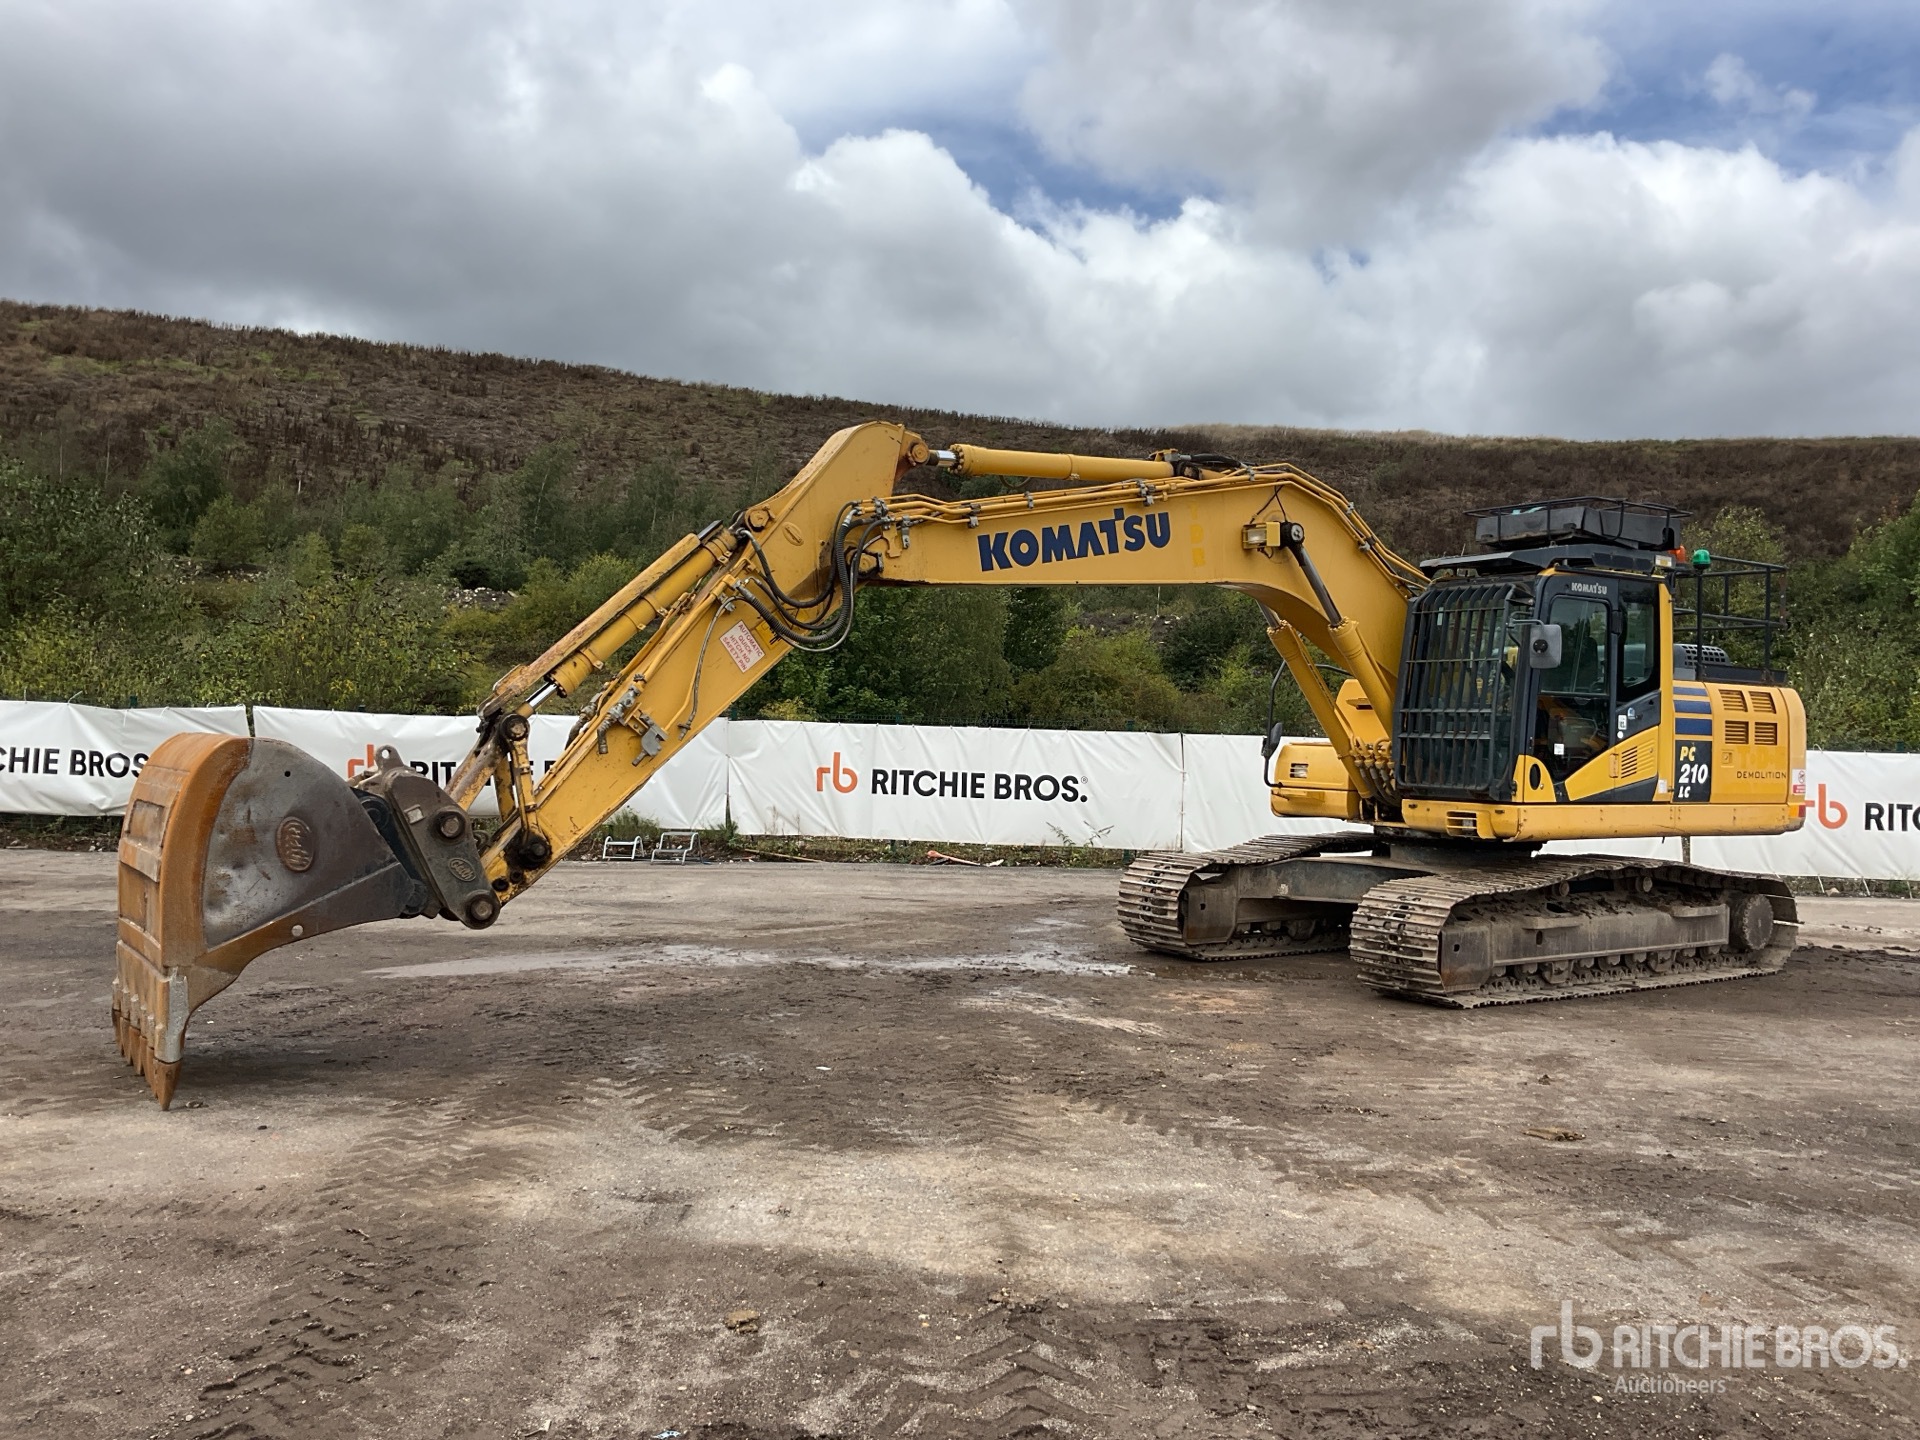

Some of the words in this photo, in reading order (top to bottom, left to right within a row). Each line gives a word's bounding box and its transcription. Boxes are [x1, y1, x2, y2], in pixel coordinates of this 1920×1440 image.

[977, 508, 1171, 572] KOMATSU
[1571, 582, 1607, 594] KOMATSU
[730, 635, 743, 653] HITCH
[742, 653, 751, 663] NO
[738, 624, 763, 657] AUTOMATIC
[738, 635, 752, 654] QUICK
[723, 637, 740, 659] SAFETY
[738, 660, 747, 670] PIN
[0, 747, 60, 775] HIE
[1680, 746, 1696, 761] PC
[816, 752, 858, 794] rb
[871, 768, 985, 798] RITCHIE
[1679, 763, 1709, 783] 210
[1736, 771, 1787, 779] DEMOLITION
[1678, 786, 1691, 798] LC
